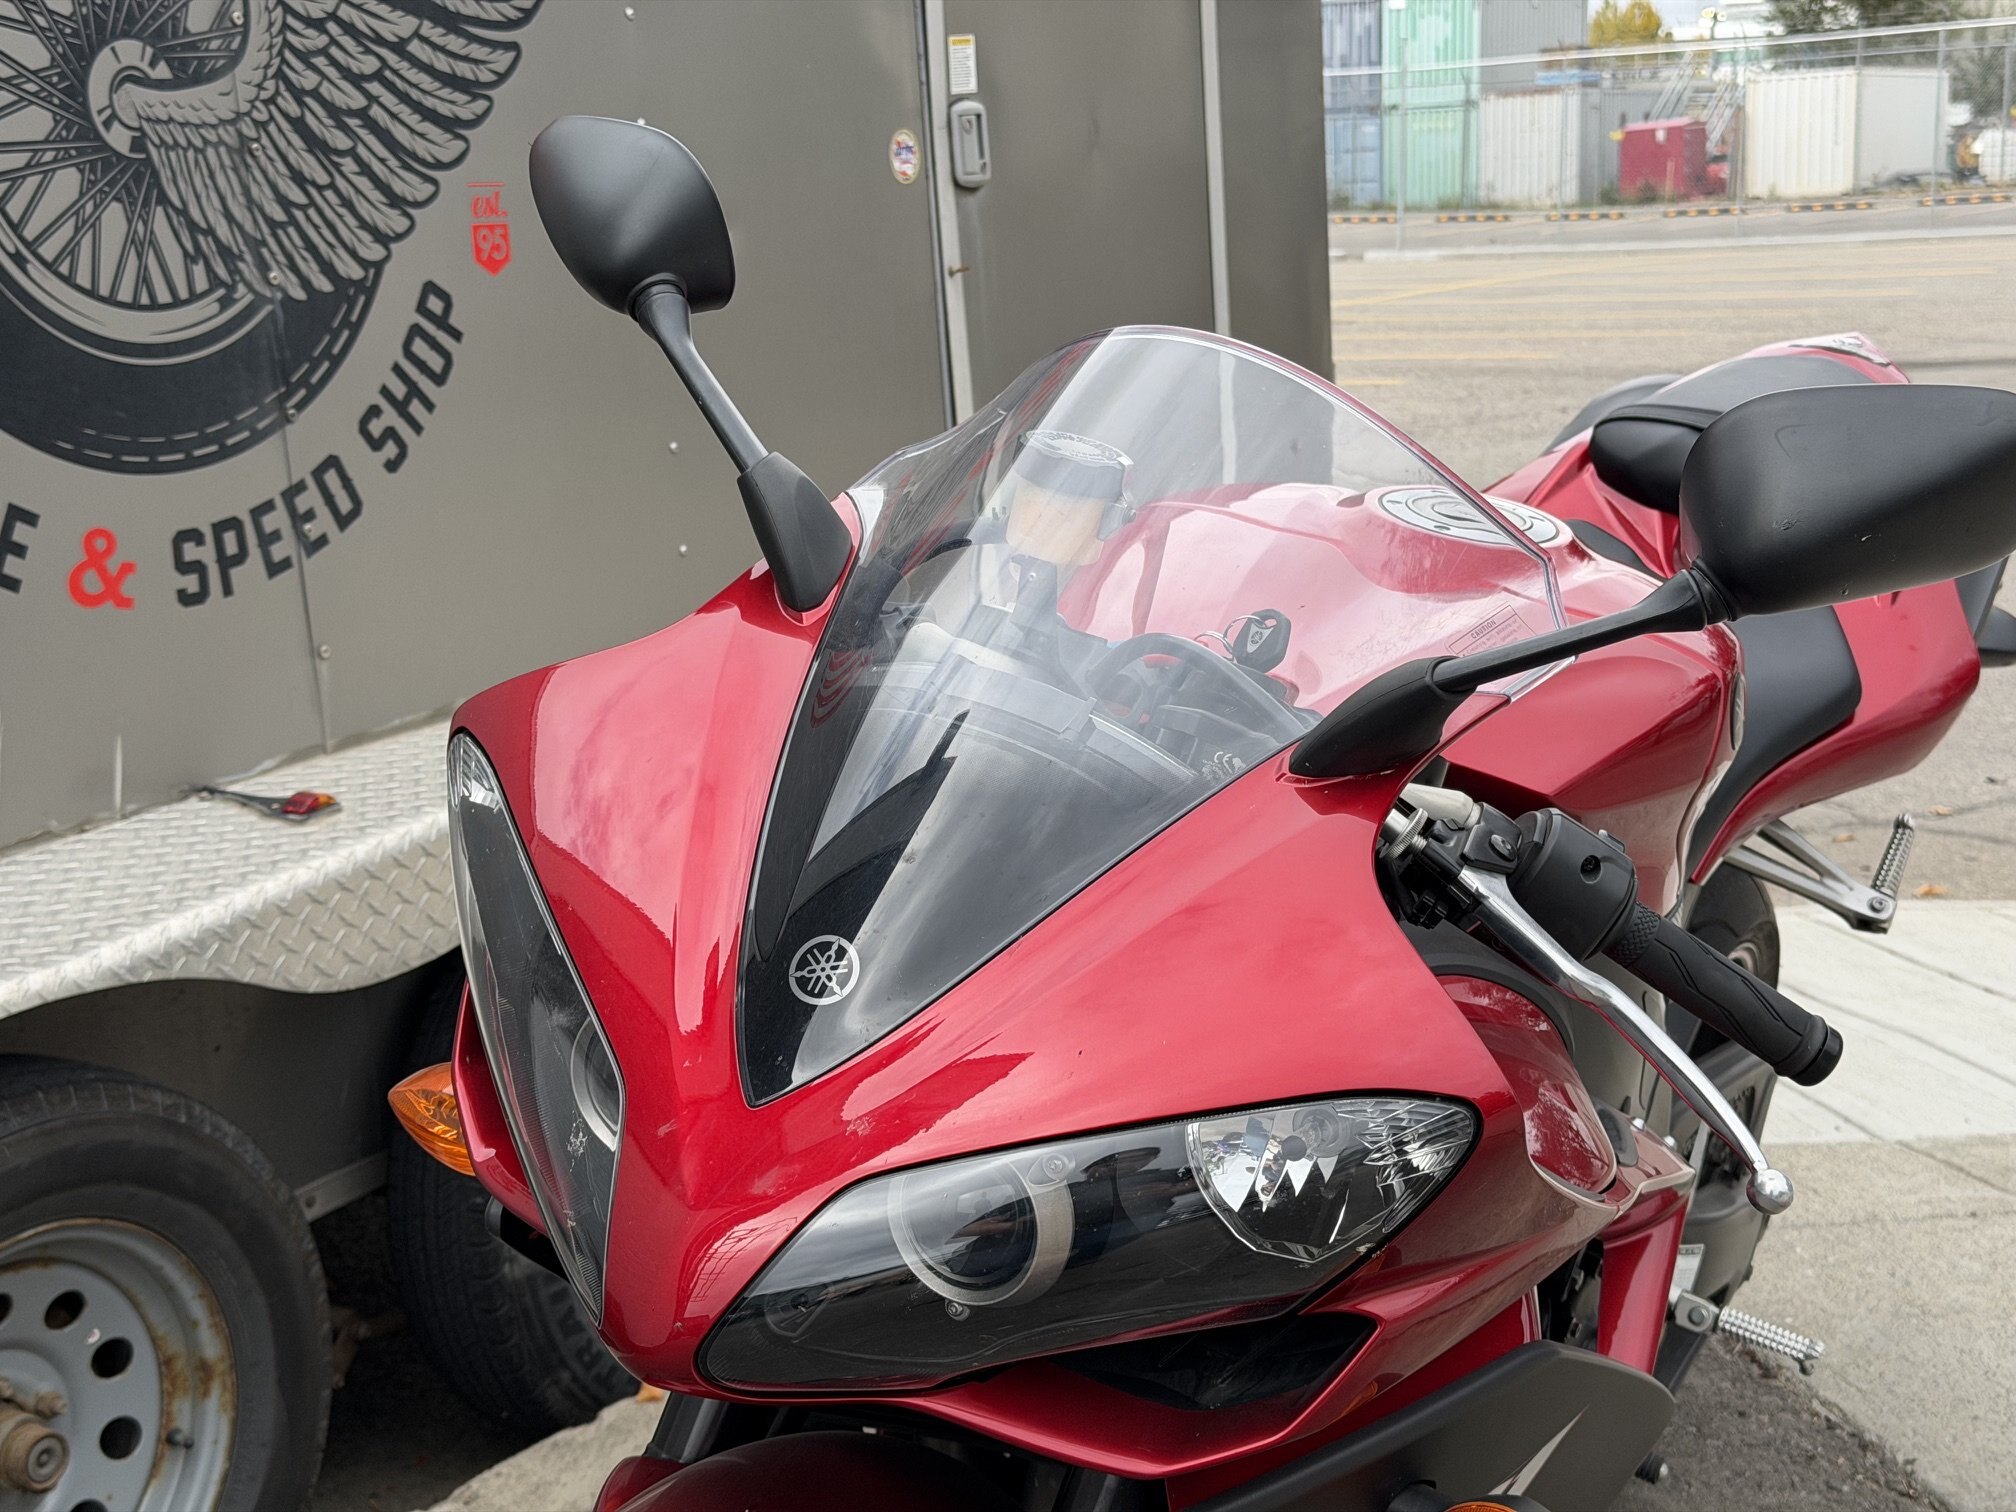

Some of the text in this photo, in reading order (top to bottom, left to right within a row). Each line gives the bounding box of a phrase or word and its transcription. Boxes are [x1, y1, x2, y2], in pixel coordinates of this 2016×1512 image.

[476, 229, 507, 261] 95
[66, 527, 138, 611] &
[172, 454, 364, 608] SPEED
[358, 279, 464, 474] SHOP
[1470, 619, 1497, 640] CAUTION
